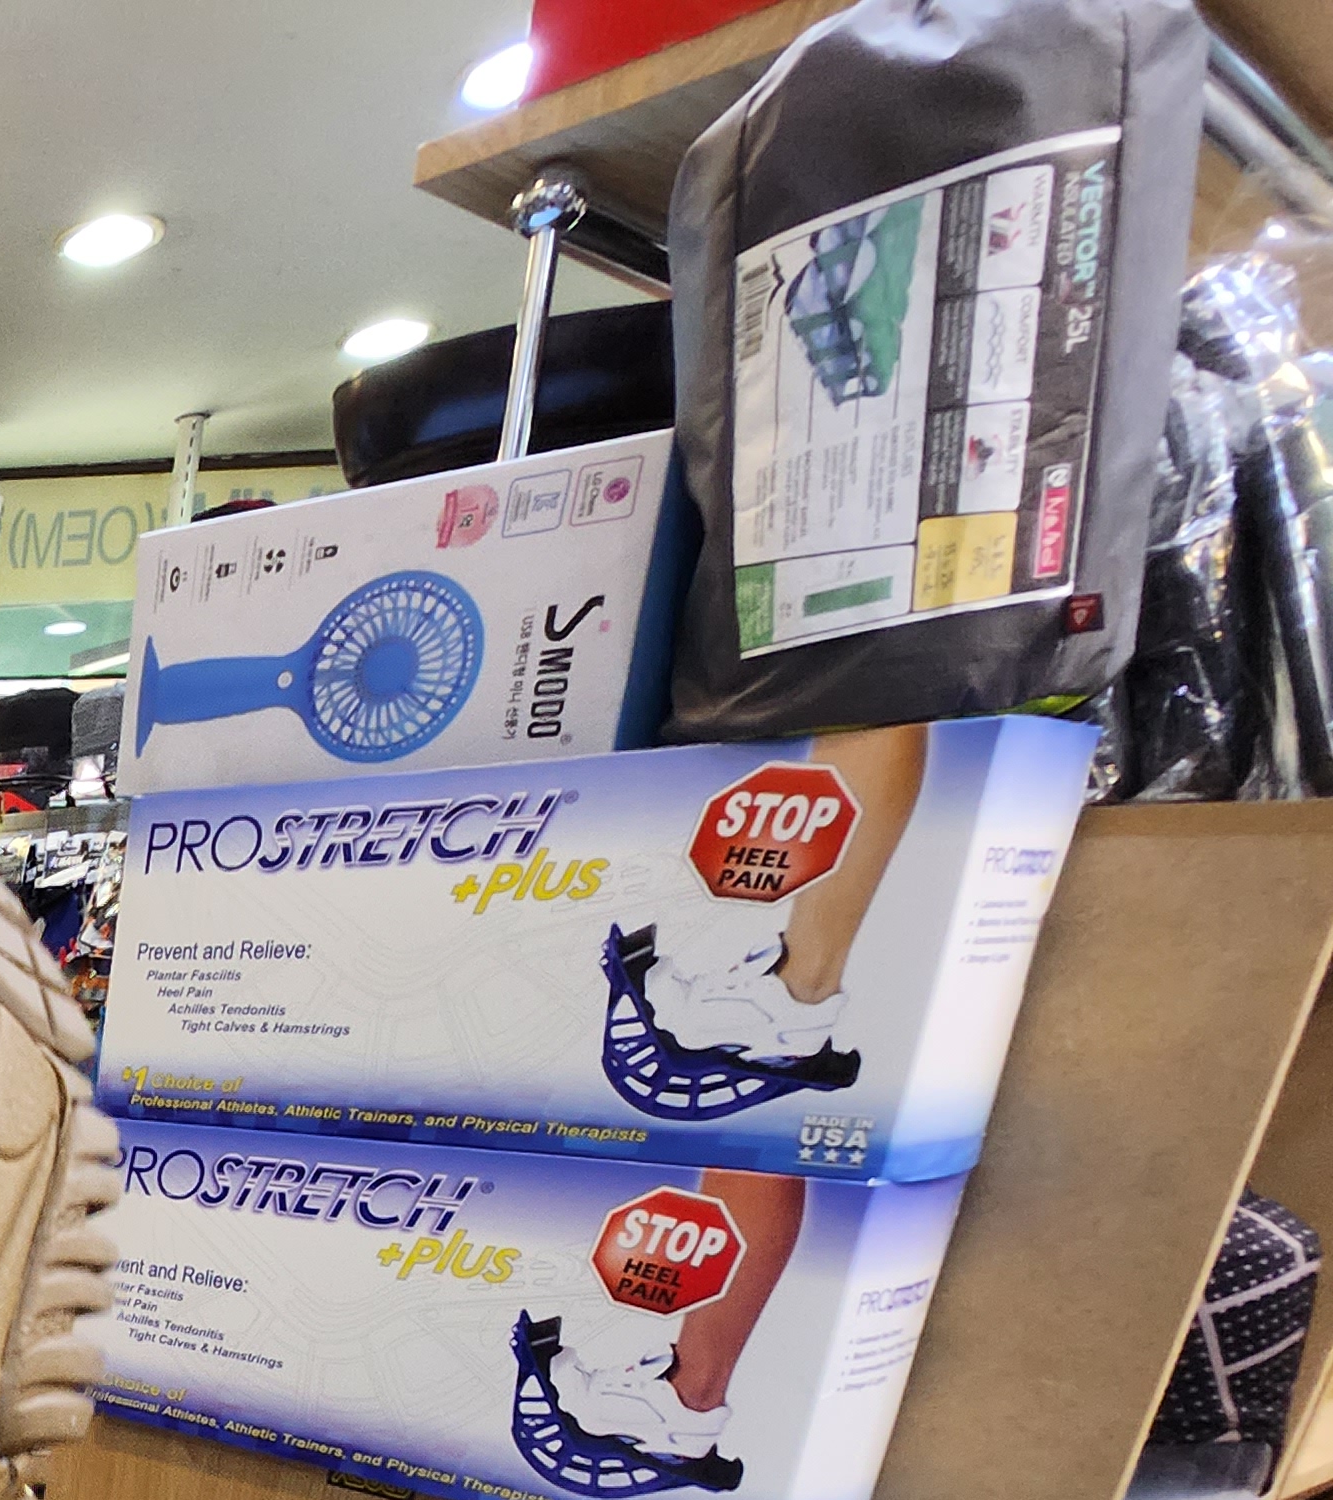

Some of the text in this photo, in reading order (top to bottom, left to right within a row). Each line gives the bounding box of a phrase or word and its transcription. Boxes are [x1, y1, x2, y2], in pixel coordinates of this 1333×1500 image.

[1066, 306, 1093, 354] 25L
[520, 613, 534, 640] USB
[716, 791, 841, 843] STOP
[144, 788, 562, 876] PROSTRETCH
[724, 846, 791, 869] HEEL
[717, 869, 785, 891] PAIN
[137, 939, 312, 961] Prevent and Relieve:
[146, 970, 242, 981] Plantar Fasciitis
[157, 987, 213, 998] Heel Pain
[167, 1003, 286, 1016] Achilles Tendonitis
[181, 1020, 351, 1038] Tight Calves & Hamstrings
[151, 1072, 215, 1092] Choice
[220, 1076, 244, 1093] of
[130, 1094, 213, 1111] Professional
[284, 1105, 341, 1120] Athletic
[348, 1108, 418, 1127] Trainers,
[423, 1113, 459, 1129] and
[461, 1116, 539, 1136] Physical
[545, 1122, 649, 1143] Therapists
[803, 1114, 875, 1129] MADE IN
[800, 1127, 868, 1149] USA
[616, 1208, 728, 1268] STOP
[148, 1264, 178, 1281] and
[182, 1266, 249, 1293] Relieve:
[623, 1258, 682, 1288] HEEL
[137, 1284, 184, 1302] Fasciitis
[615, 1277, 677, 1307] PAIN
[133, 1299, 158, 1312] Pain
[116, 1311, 225, 1341] Achilles Tendonitis
[128, 1328, 284, 1370] Tight Calves & Hamstrings
[166, 1388, 187, 1402] of
[224, 1420, 278, 1442] Athletic
[282, 1433, 347, 1461] Trainers,
[352, 1451, 383, 1468] and
[386, 1458, 458, 1486] Physical
